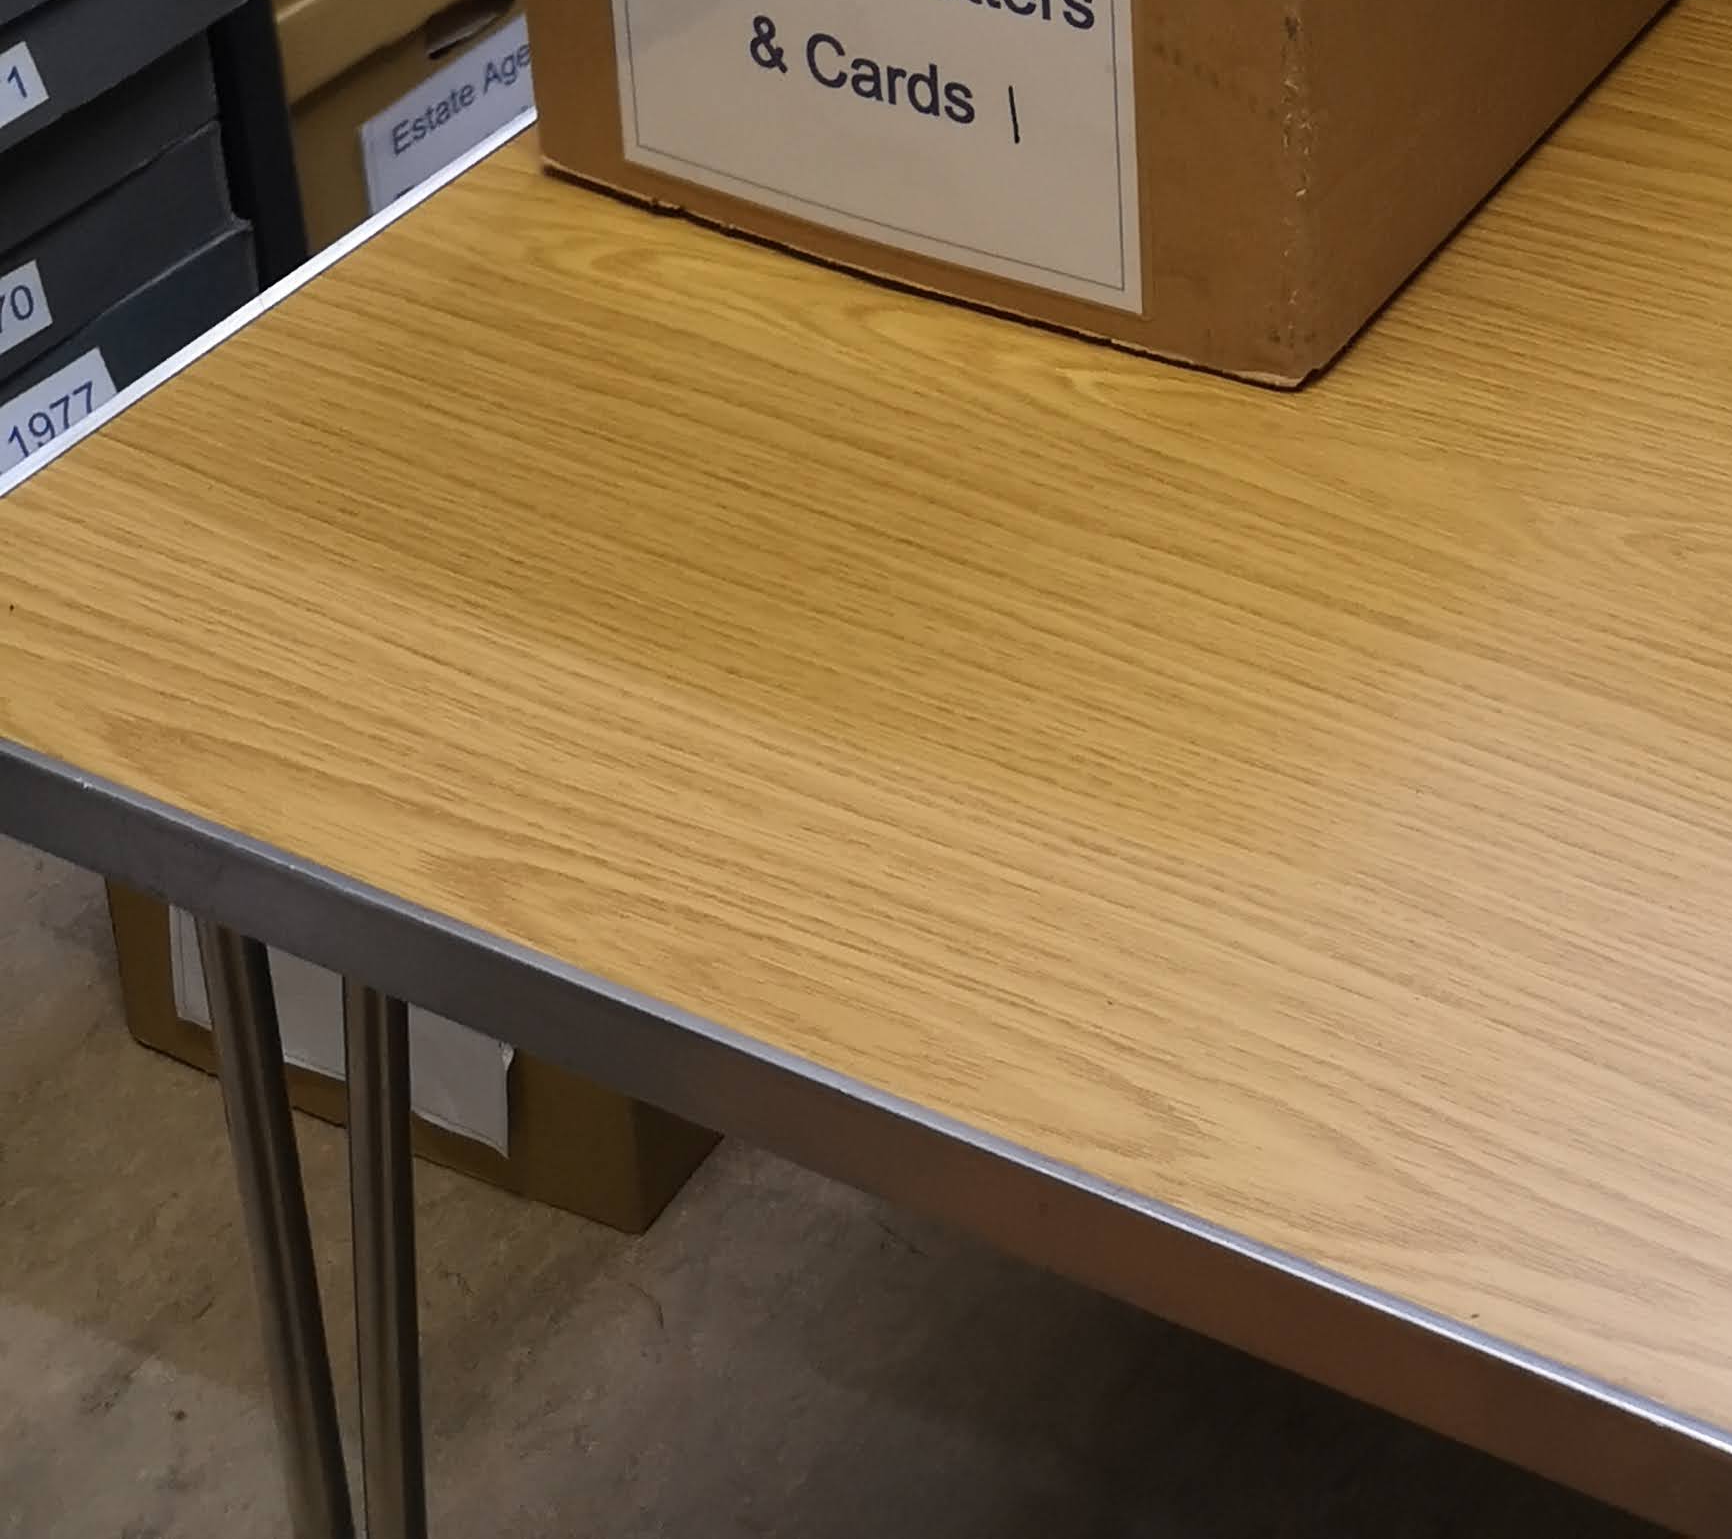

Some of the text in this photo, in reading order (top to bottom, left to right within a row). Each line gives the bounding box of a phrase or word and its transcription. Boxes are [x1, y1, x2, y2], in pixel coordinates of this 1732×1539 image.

[7, 65, 29, 98] 1
[749, 15, 789, 75] &
[805, 32, 976, 126] Cards
[391, 83, 476, 157] Estate
